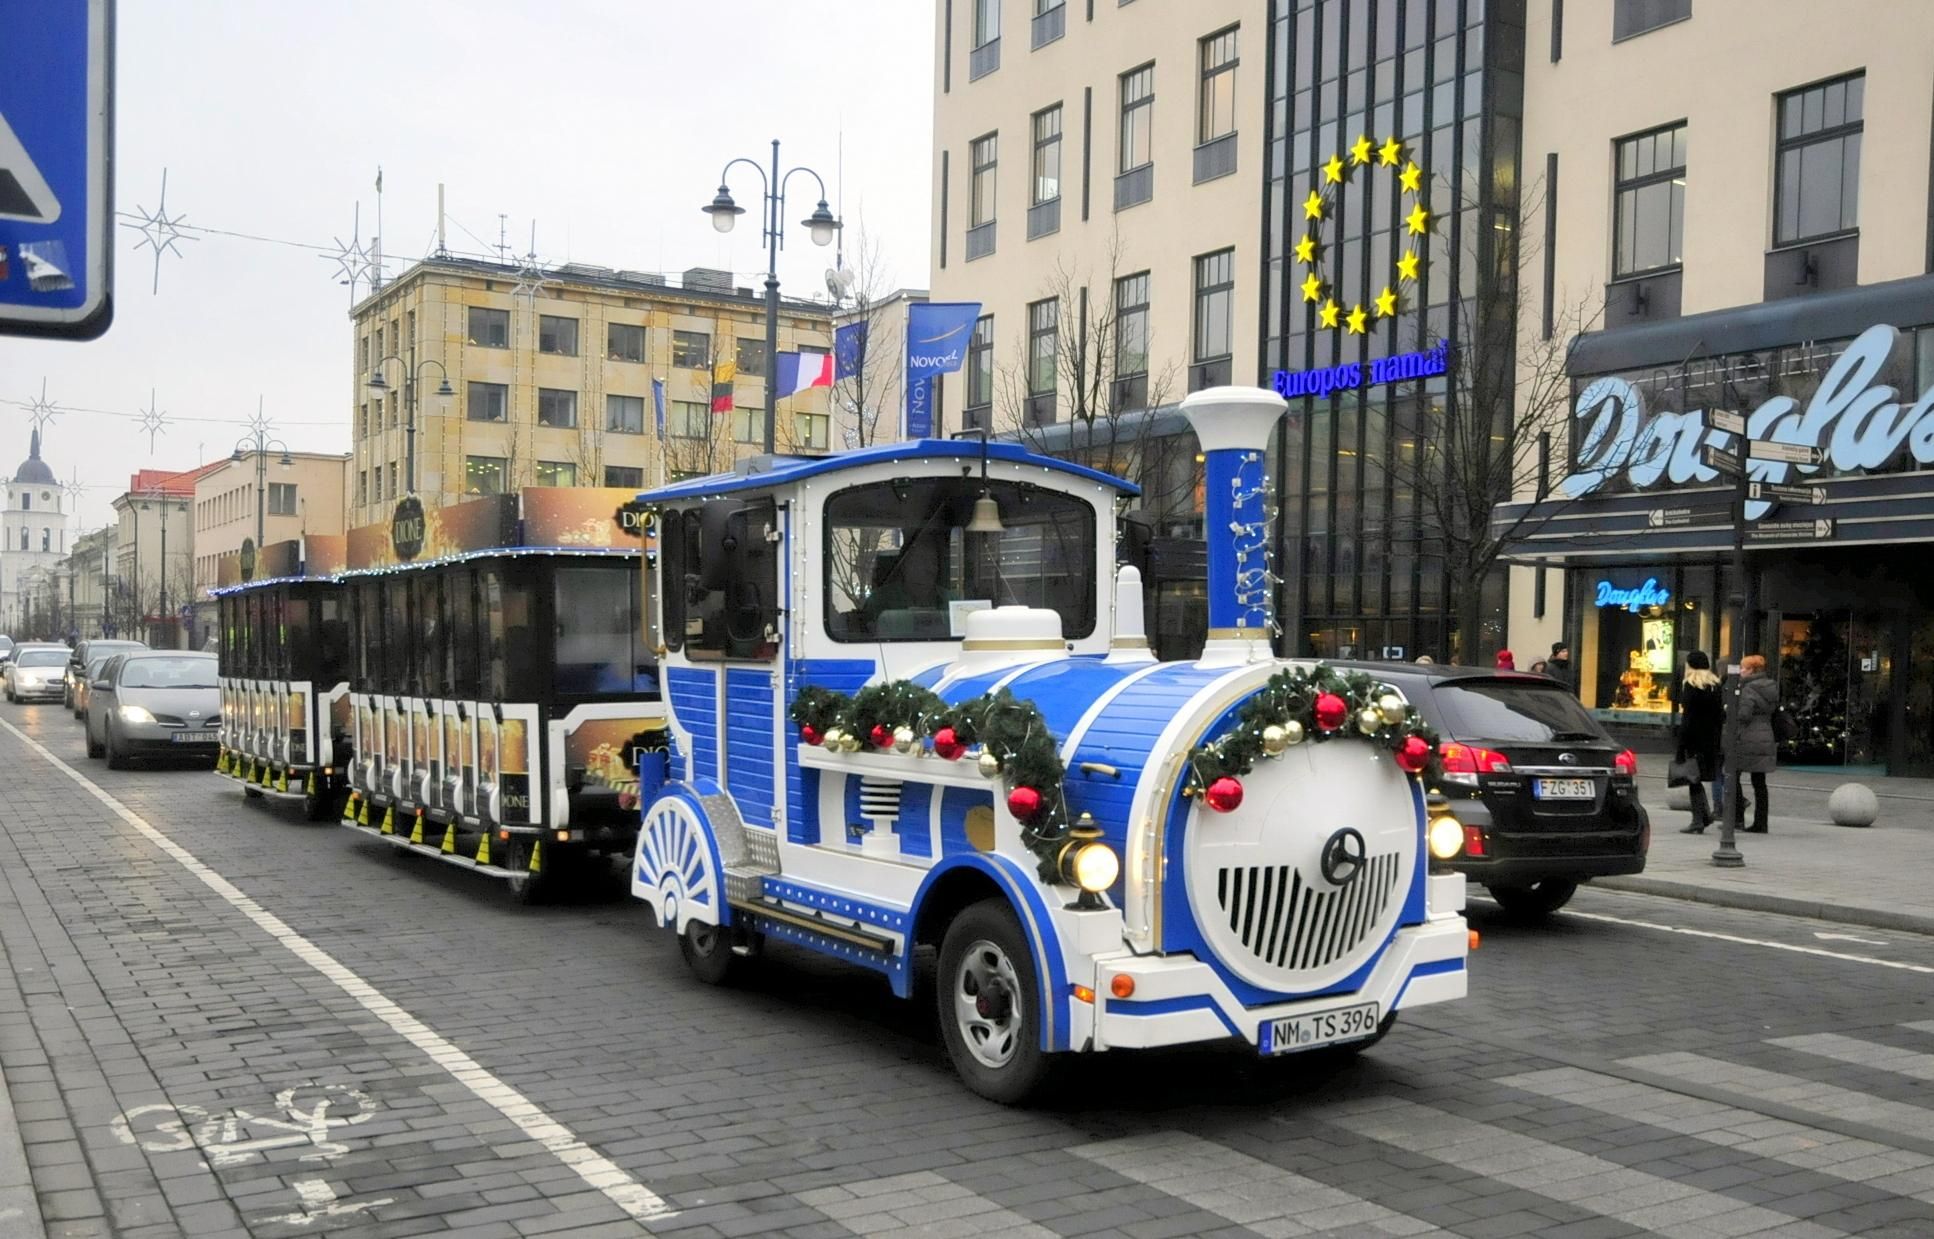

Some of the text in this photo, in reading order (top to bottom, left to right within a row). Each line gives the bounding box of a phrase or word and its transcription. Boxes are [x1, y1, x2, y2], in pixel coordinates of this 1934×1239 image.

[910, 349, 958, 368] NOVOL
[1272, 339, 1449, 400] Europos namai
[395, 517, 421, 544] DIONE
[1595, 578, 1670, 613] Douglas
[632, 745, 670, 766] DO
[1540, 781, 1593, 795] FZG 351
[1273, 1021, 1300, 1047] NM
[1313, 1014, 1336, 1040] TS
[1340, 1007, 1374, 1035] 396
